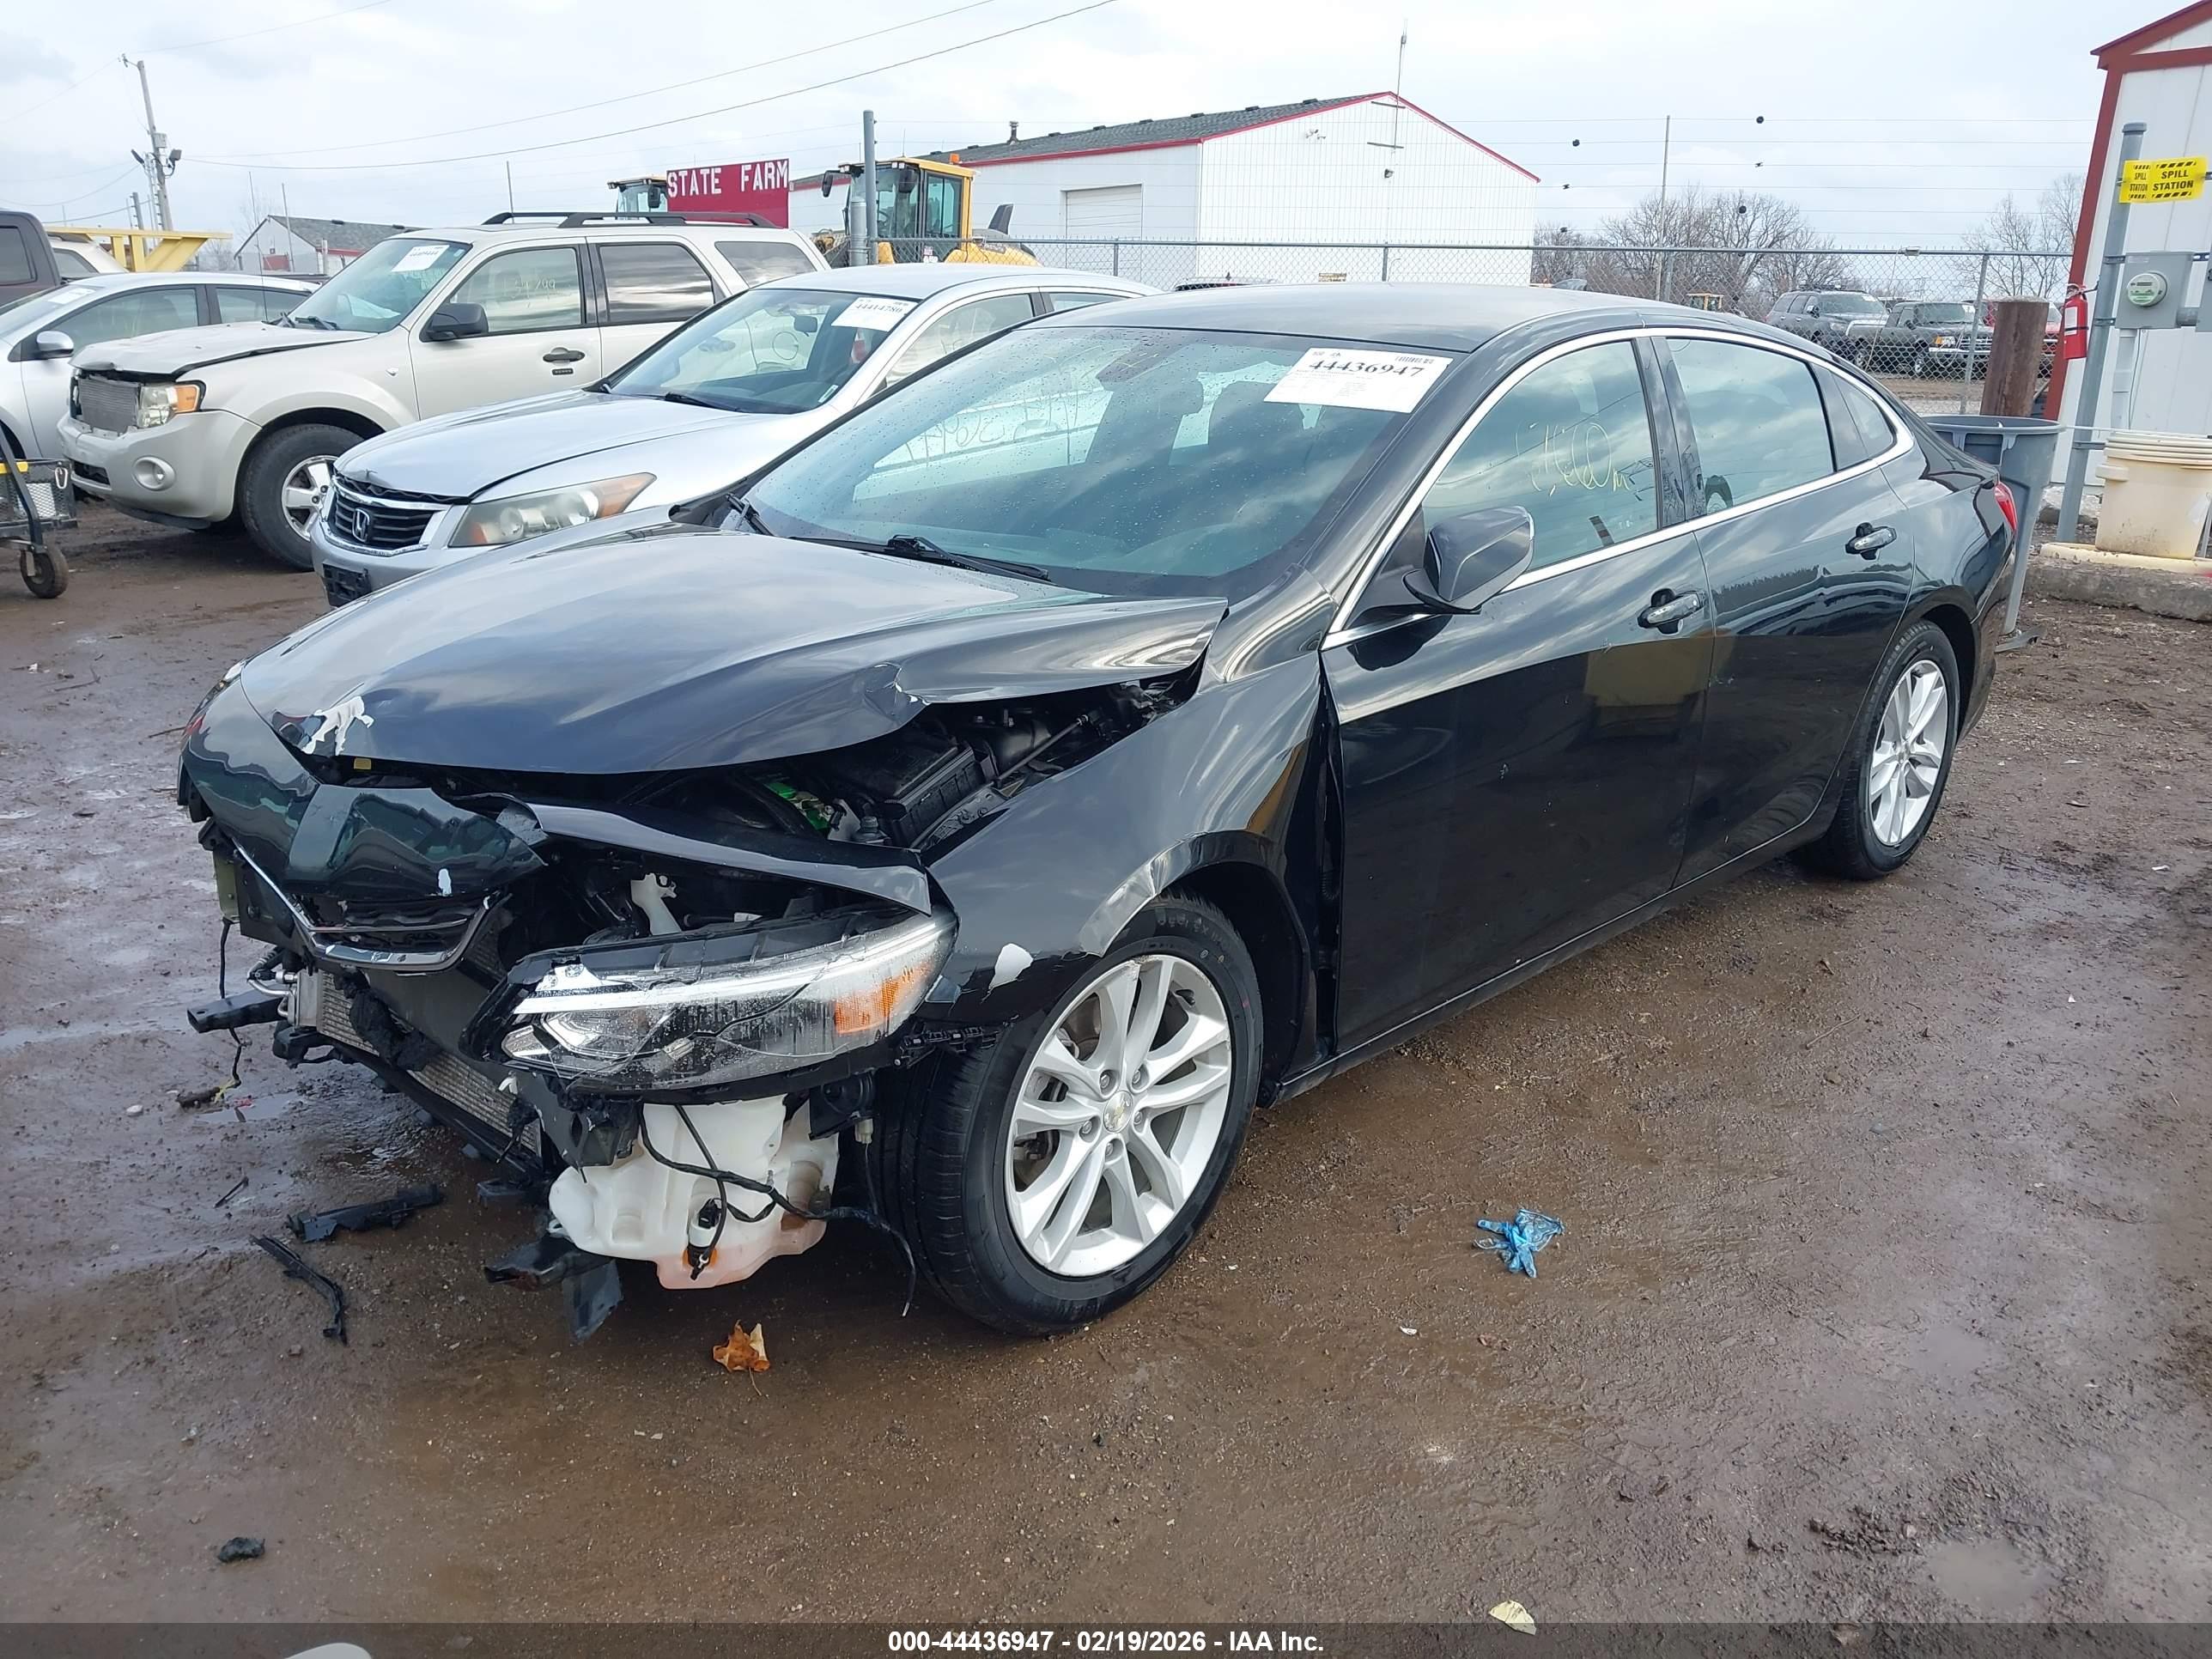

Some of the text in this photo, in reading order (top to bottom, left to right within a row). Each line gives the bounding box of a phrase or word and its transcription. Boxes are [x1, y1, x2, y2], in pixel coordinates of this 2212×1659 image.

[667, 160, 788, 198] STATE FARM
[2134, 172, 2147, 180] SPILL
[2160, 169, 2189, 179] SPILL
[2130, 183, 2148, 191] STATION
[2153, 180, 2194, 191] STATION
[1309, 359, 1425, 378] 44436947
